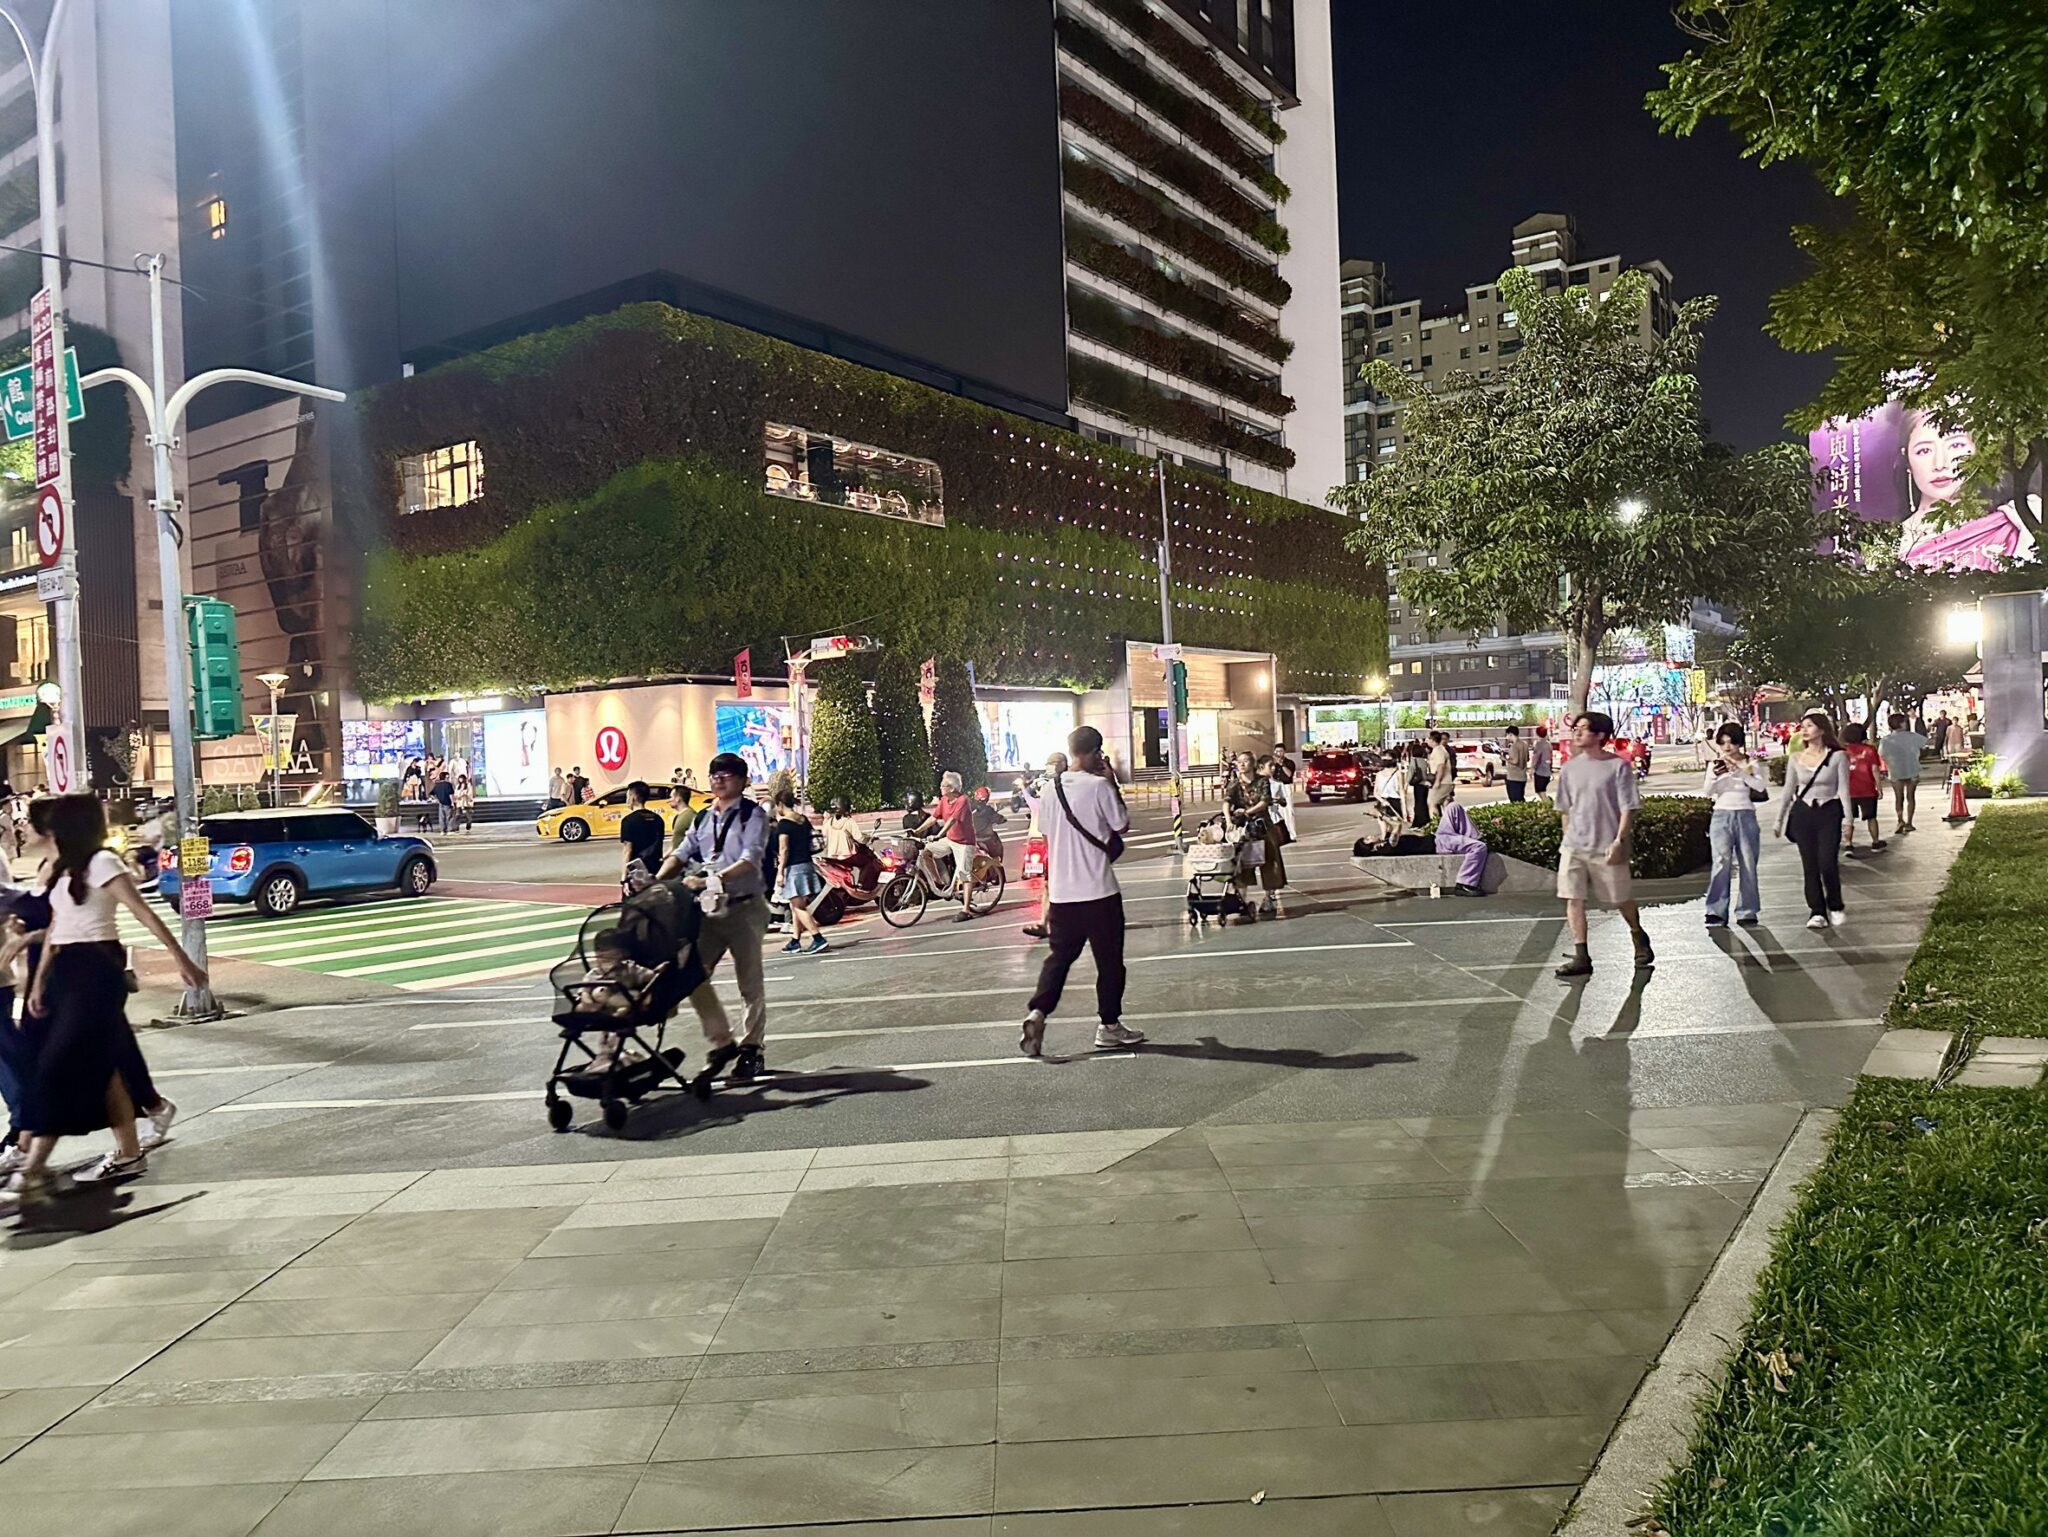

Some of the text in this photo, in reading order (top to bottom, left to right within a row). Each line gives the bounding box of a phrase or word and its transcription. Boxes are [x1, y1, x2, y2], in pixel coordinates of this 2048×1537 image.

[1854, 453, 1861, 461] to
[1854, 462, 1862, 474] the
[1854, 475, 1862, 488] real
[1853, 489, 1861, 502] you
[189, 900, 209, 910] 668
